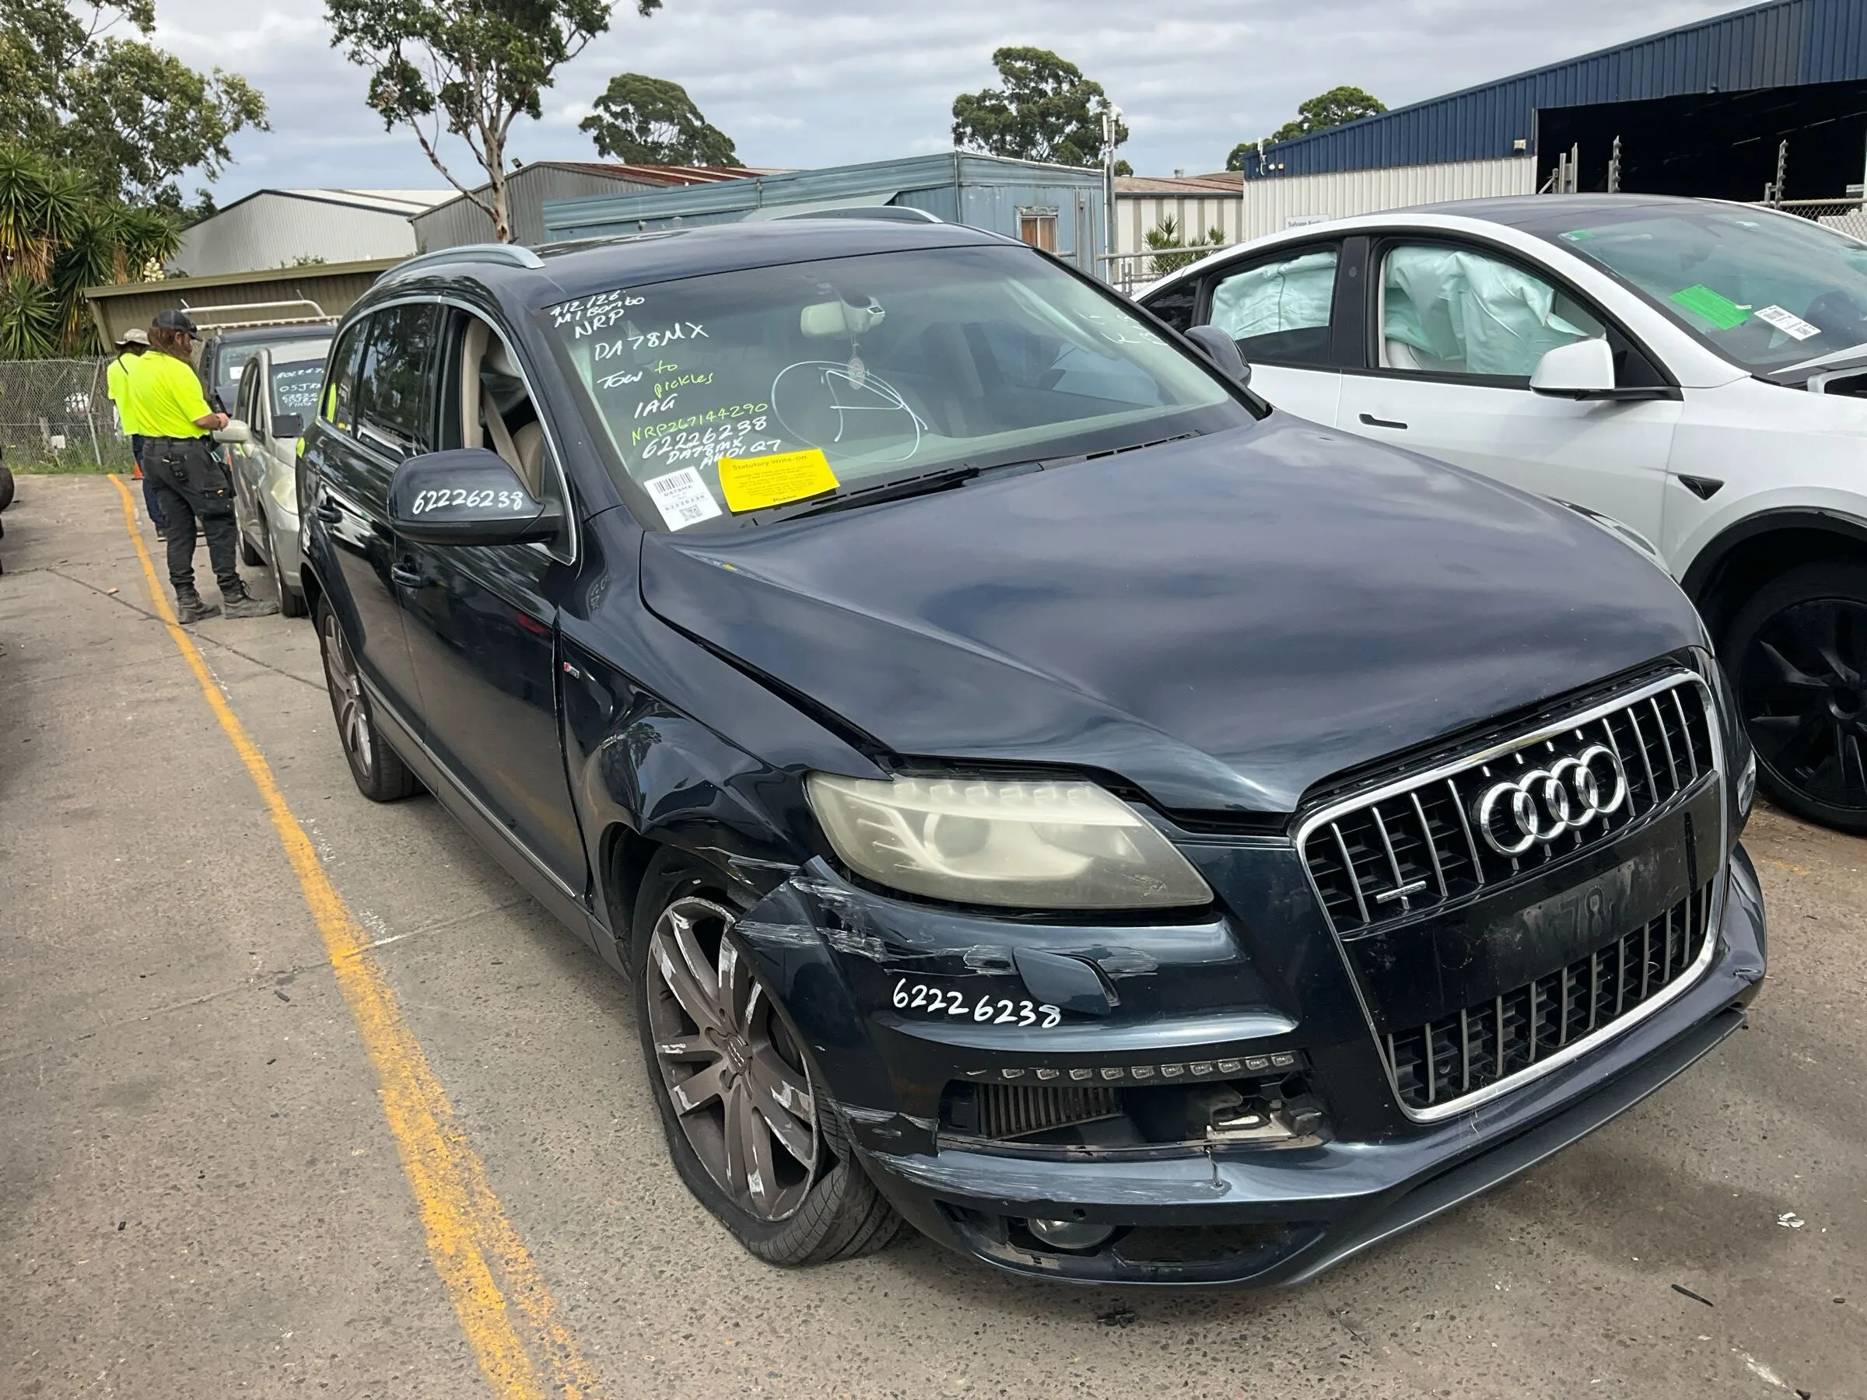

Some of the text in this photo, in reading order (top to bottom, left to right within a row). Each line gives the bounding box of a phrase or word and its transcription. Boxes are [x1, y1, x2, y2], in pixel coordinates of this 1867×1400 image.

[575, 309, 624, 338] NRP
[595, 322, 709, 361] DA78MX
[654, 360, 678, 374] to
[631, 403, 768, 446] NRP267144290
[642, 416, 767, 459] 62226238
[412, 489, 524, 514] 62226238
[893, 977, 1061, 1028] 62226238
